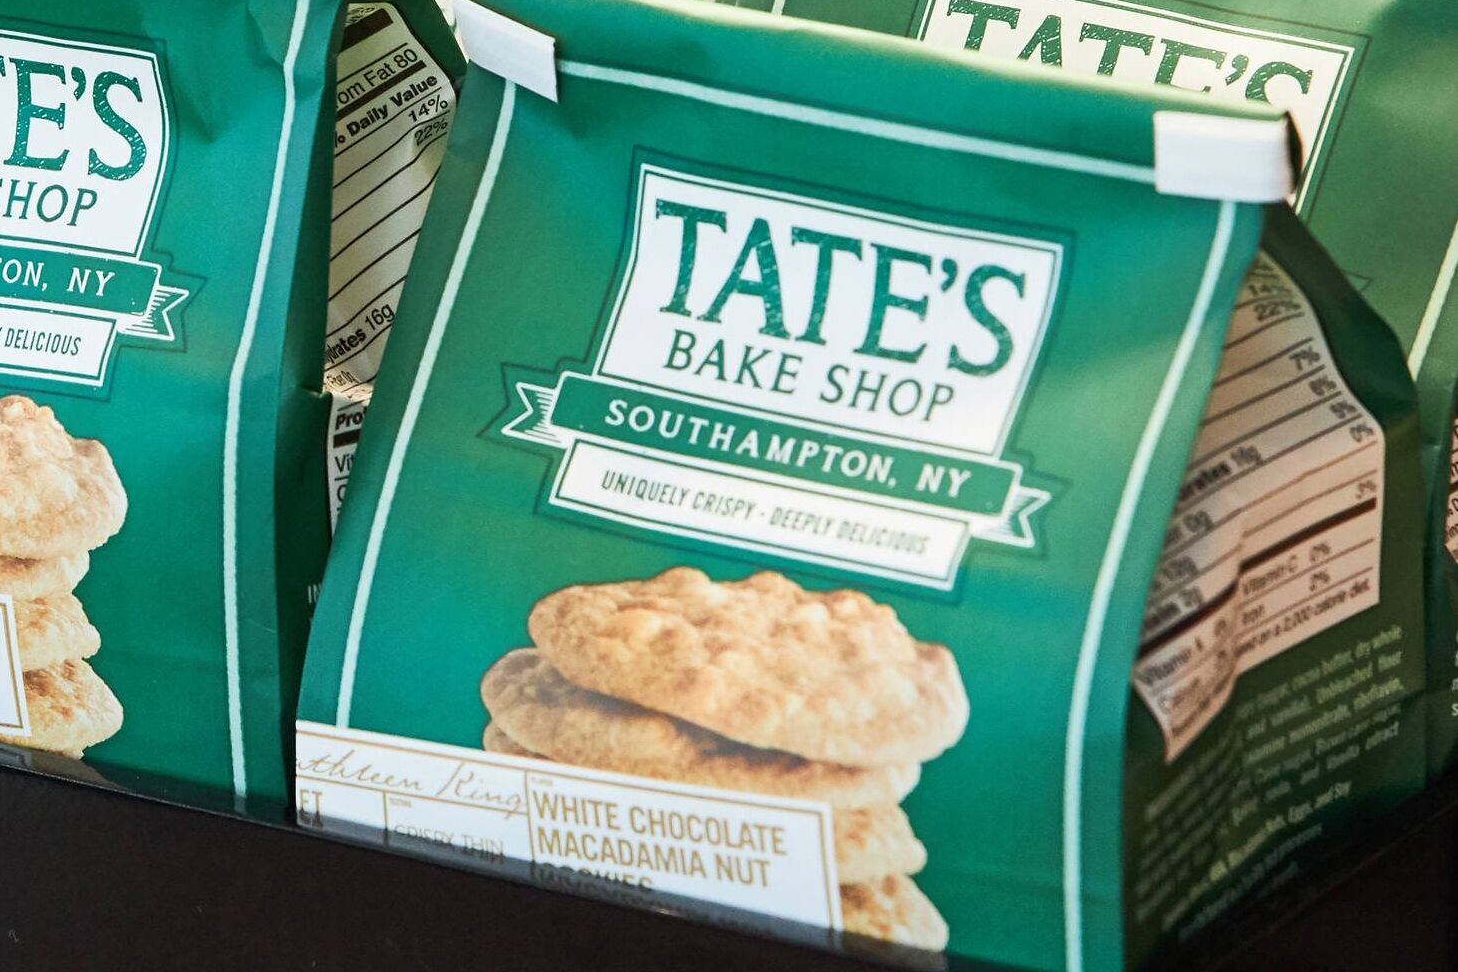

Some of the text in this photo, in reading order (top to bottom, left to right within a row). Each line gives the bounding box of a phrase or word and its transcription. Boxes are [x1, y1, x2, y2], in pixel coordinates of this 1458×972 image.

[363, 65, 395, 88] Fat
[394, 48, 418, 69] 80
[346, 103, 389, 137] Daily
[389, 75, 438, 108] Value
[408, 95, 448, 123] 14%
[414, 117, 448, 146] 22%
[67, 267, 116, 298] NY
[655, 198, 1026, 377] TATE'S
[4, 327, 83, 356] DELICIOUS
[365, 303, 396, 331] 16g
[663, 329, 955, 422] BAKE SHOP
[604, 398, 972, 498] SOUTHAMPTON, NY
[601, 469, 690, 507] UNIQUELY
[692, 490, 756, 521] CRISPY
[769, 506, 836, 536] DEEPLY
[533, 790, 788, 856] WHITE CHOCOLATE
[537, 825, 707, 879] MACADAMIA
[713, 853, 771, 888] NUT
